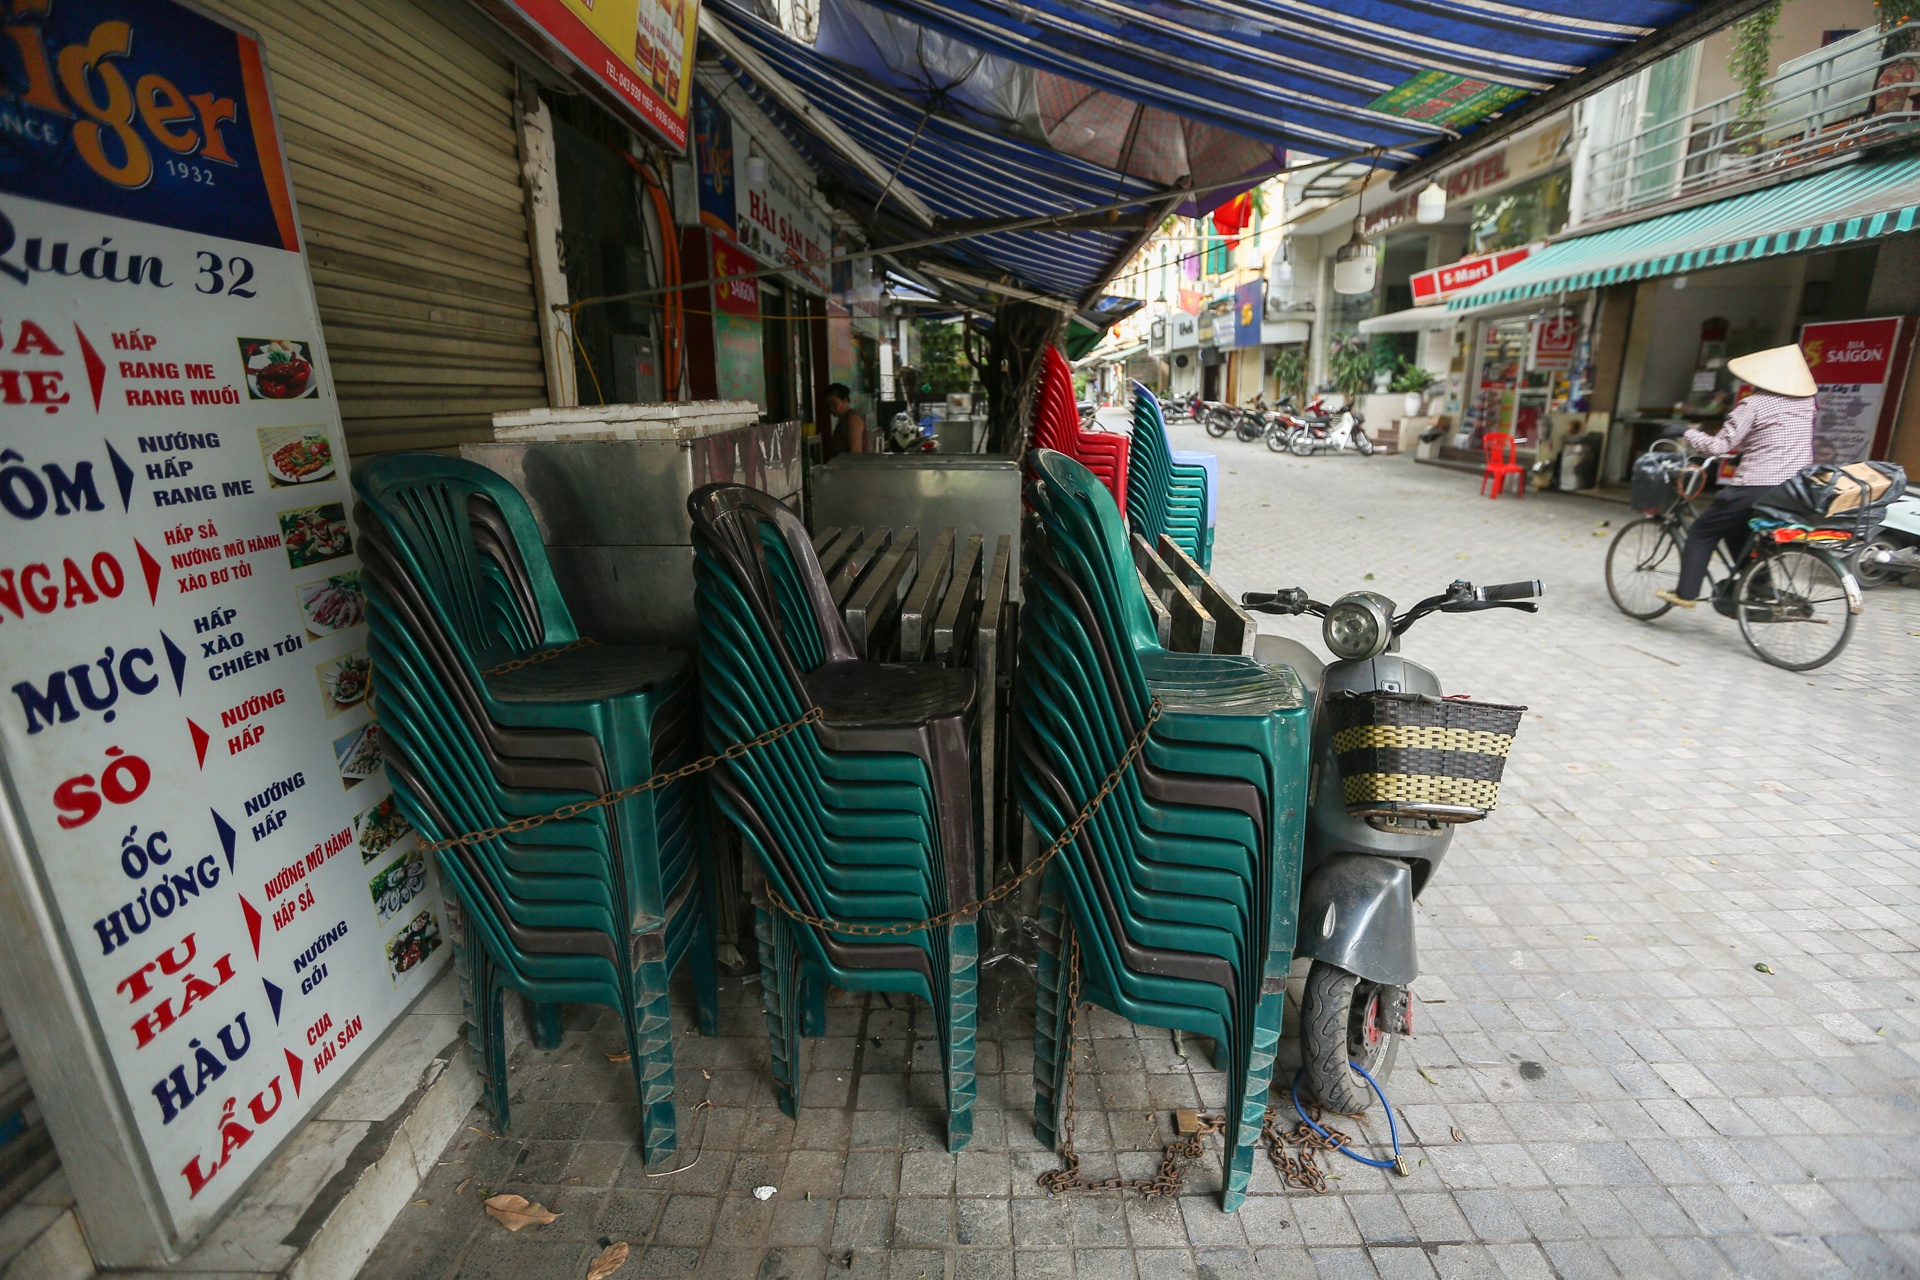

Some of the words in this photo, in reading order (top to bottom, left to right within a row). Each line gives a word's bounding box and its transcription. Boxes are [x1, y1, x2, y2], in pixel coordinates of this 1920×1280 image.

[0, 0, 238, 189] iger
[0, 112, 59, 144] NCE
[165, 159, 215, 186] 1932
[1447, 153, 1508, 198] HOTEL
[194, 250, 257, 299] 32
[112, 327, 156, 351] HẤP
[1825, 347, 1884, 363] SAIGON
[0, 369, 70, 414] HẸ
[119, 362, 179, 379] RANG
[185, 364, 215, 379] ME
[125, 390, 185, 406] RANG
[190, 384, 240, 405] MUỐI
[138, 432, 220, 453] NƯỚNG
[0, 449, 105, 520] ÔM
[146, 456, 193, 480] HẤP
[153, 485, 217, 507] RANG
[222, 480, 254, 497] ME
[164, 523, 193, 545] HẤP
[198, 519, 218, 539] SẢ
[171, 547, 221, 569] NƯỚNG
[224, 539, 245, 558] MỠ
[247, 534, 281, 552] HÀNH
[178, 574, 207, 593] XÀO
[210, 567, 229, 585] BƠ
[231, 560, 252, 579] TỎI
[194, 607, 236, 634] HẤP
[201, 632, 244, 658] XÀO
[209, 648, 270, 681] CHIÊN
[273, 635, 302, 656] TỎI
[12, 647, 159, 735] MỰC
[221, 689, 285, 728] NƯỚNG
[228, 726, 264, 755] HẤP
[53, 746, 151, 829] SÒ
[244, 772, 305, 817] NƯỚNG
[252, 810, 287, 842] HẤP
[121, 825, 171, 879] ỐC
[265, 861, 305, 901] NƯỚNG
[324, 827, 352, 859] HÀNH
[93, 855, 220, 955] HƯƠNG
[273, 901, 295, 931] HẤP
[298, 883, 315, 911] SẢ
[117, 933, 196, 1004] TU
[293, 921, 348, 974] NƯỚNG
[307, 1013, 332, 1047] CUA
[314, 1042, 336, 1074] HẢI
[338, 1015, 362, 1049] SẢN
[152, 1012, 250, 1126] HÀU
[181, 1076, 282, 1199] LẨU
